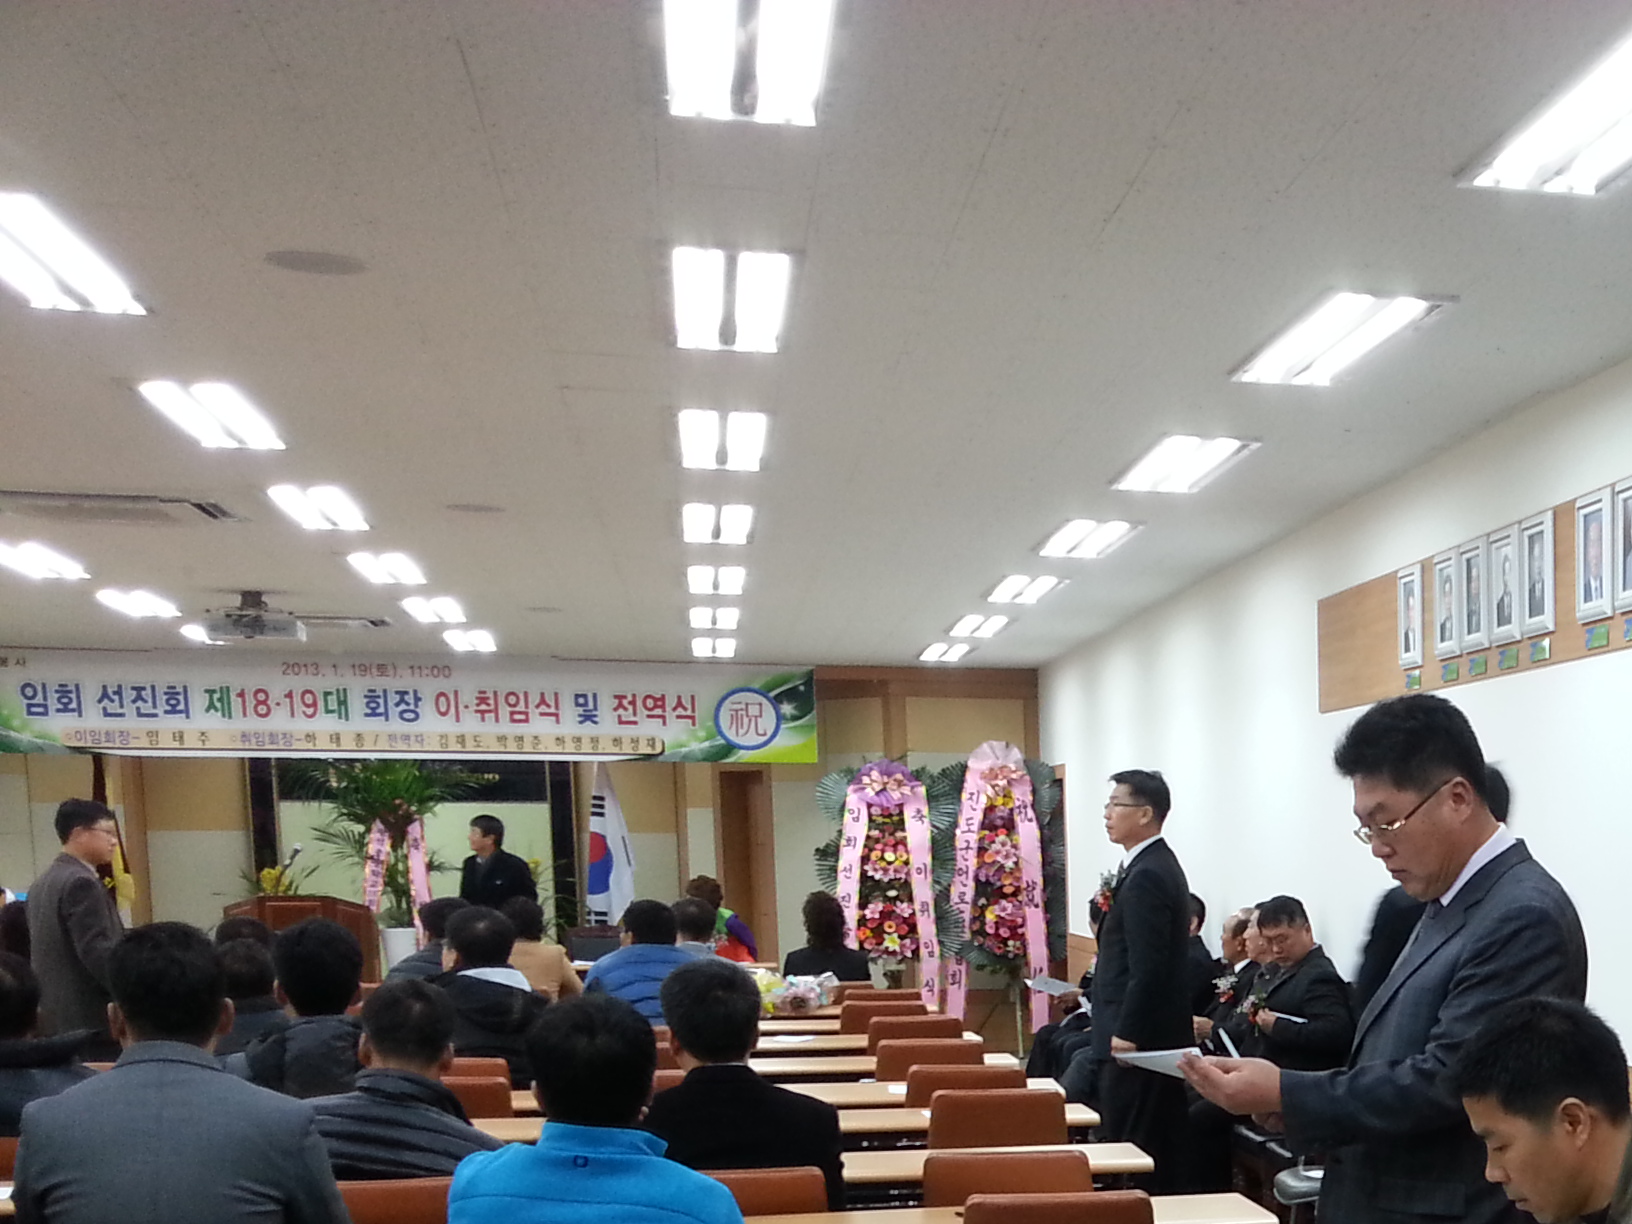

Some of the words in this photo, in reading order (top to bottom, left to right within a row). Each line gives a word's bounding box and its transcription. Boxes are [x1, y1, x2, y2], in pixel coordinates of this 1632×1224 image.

[409, 665, 452, 678] 11:00
[20, 682, 83, 718] 임회
[96, 683, 191, 719] 선진회
[363, 688, 422, 723] 회장
[434, 689, 561, 724] 이·취임식
[574, 692, 600, 725] 및
[612, 693, 697, 727] 전역식
[728, 701, 768, 738] 祝
